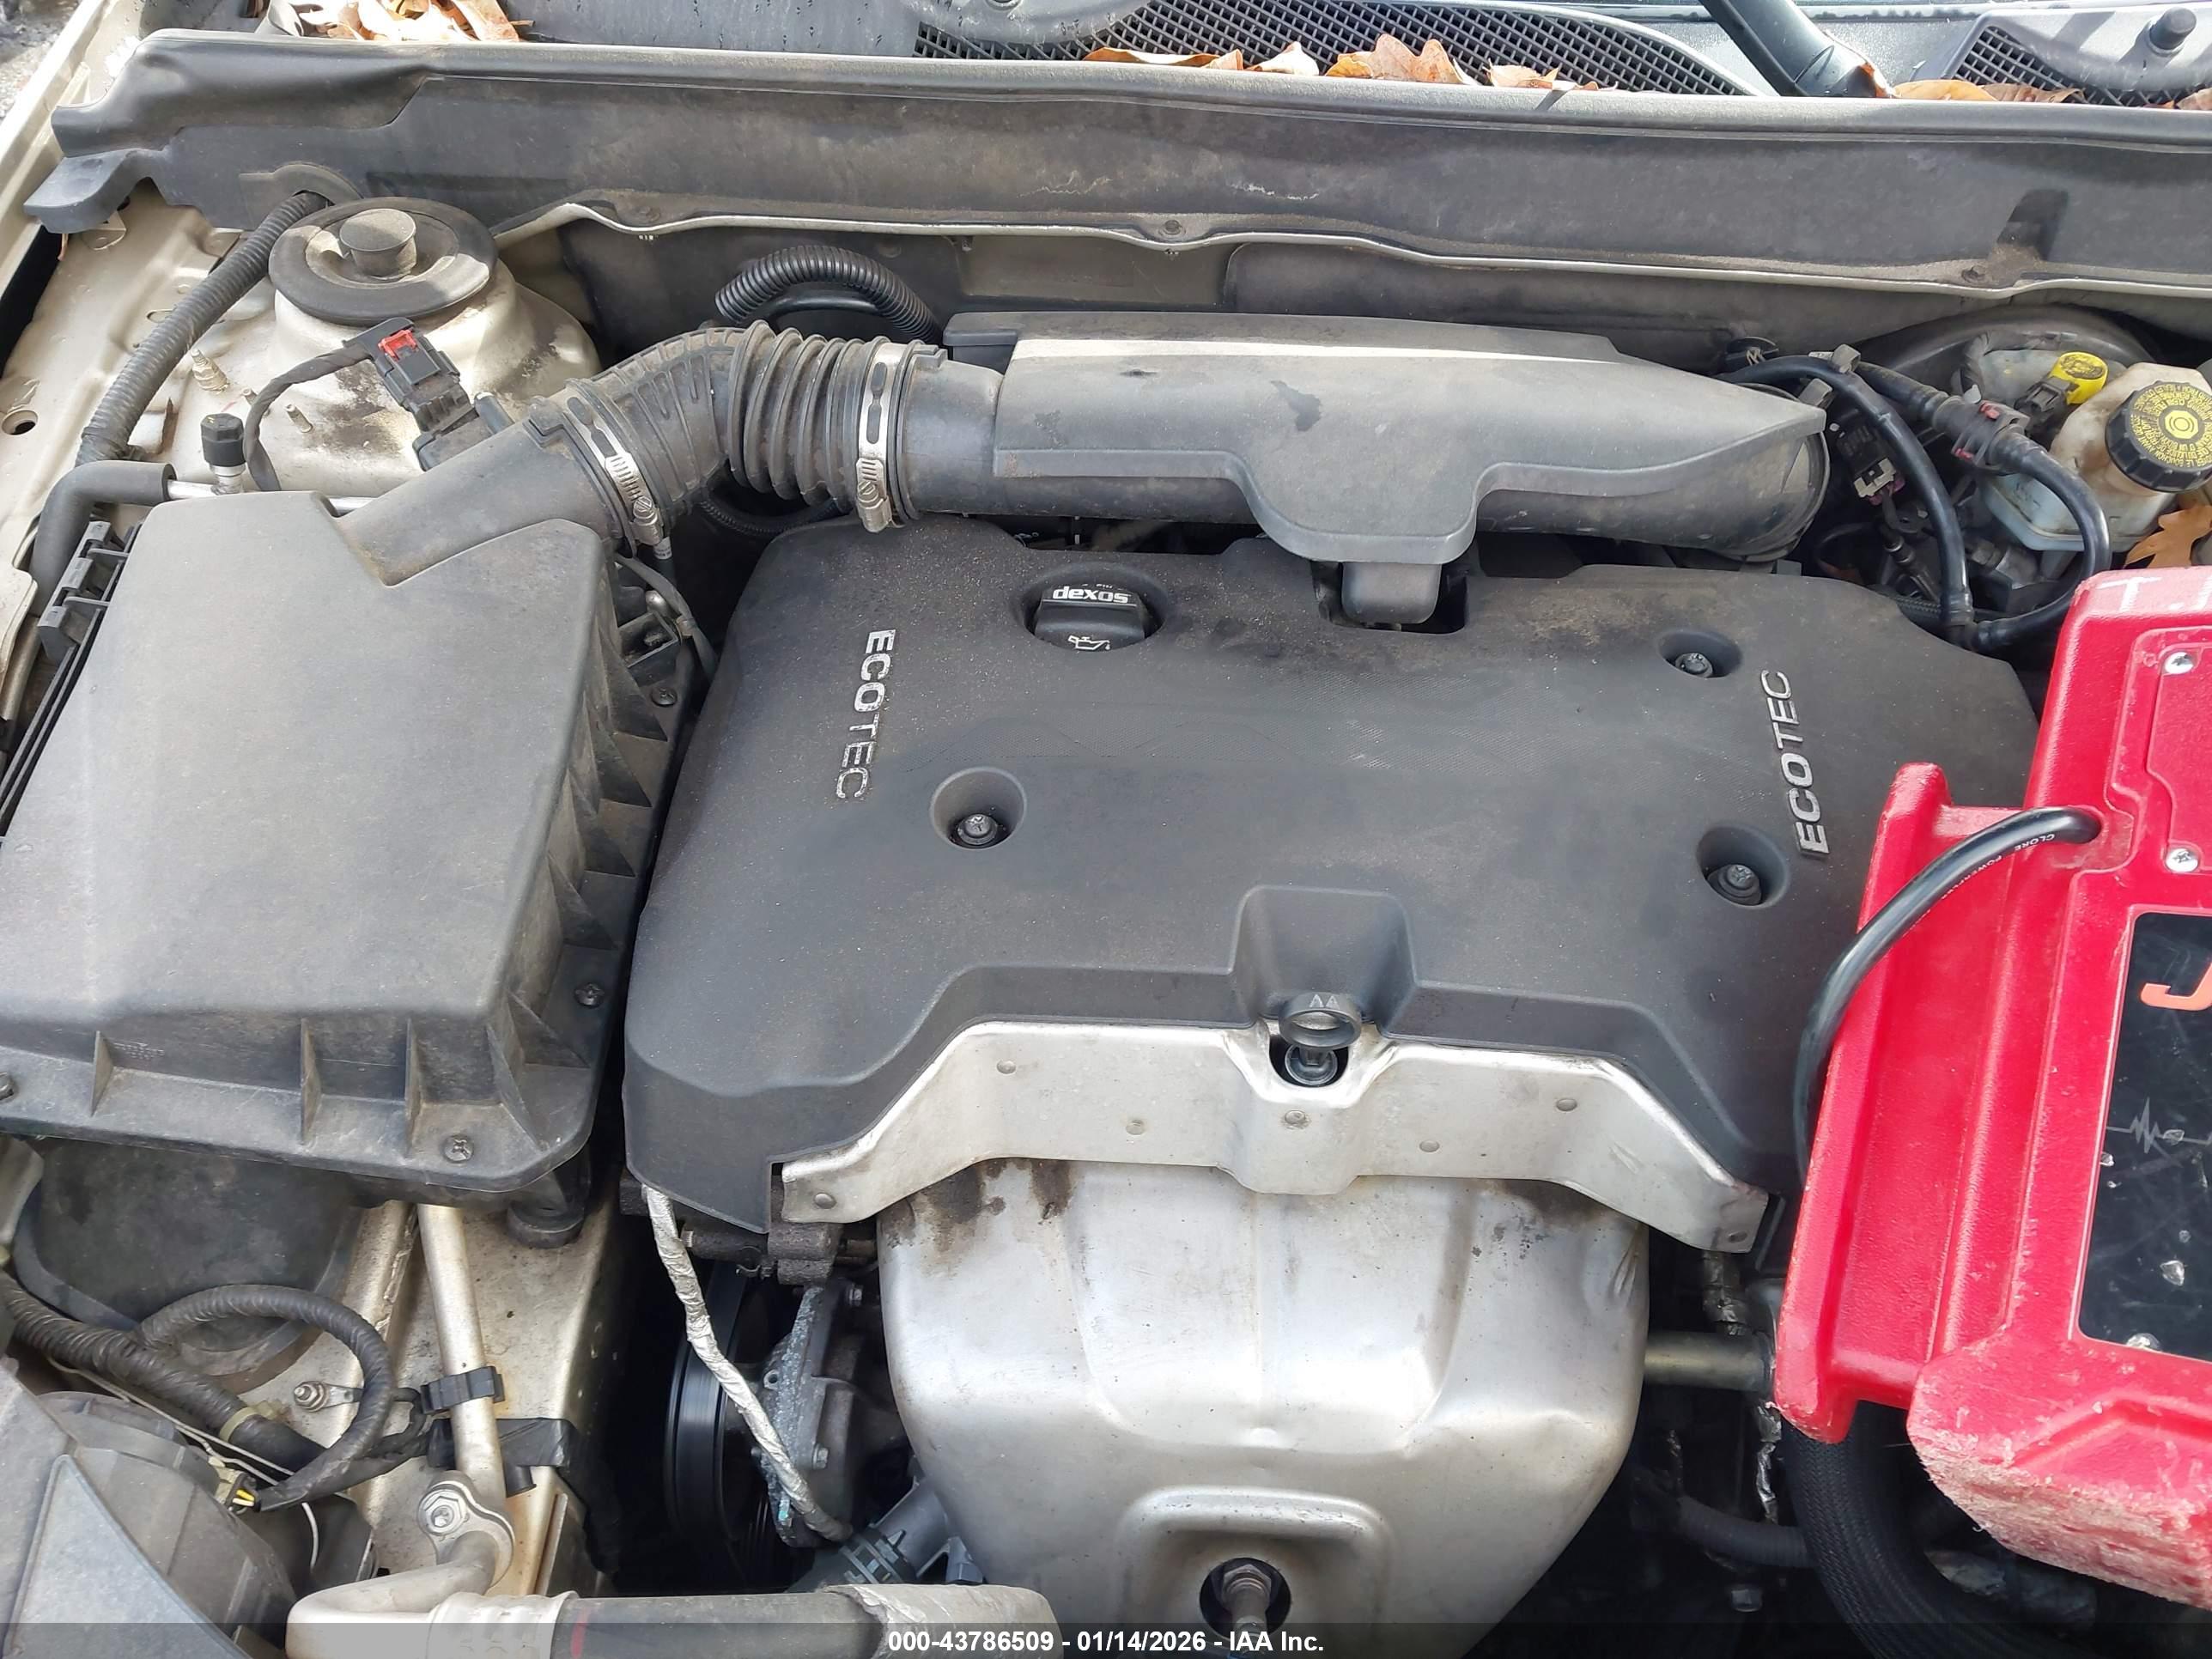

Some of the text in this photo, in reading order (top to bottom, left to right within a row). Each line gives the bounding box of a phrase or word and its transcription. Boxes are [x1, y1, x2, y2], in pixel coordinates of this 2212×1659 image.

[1052, 586, 1132, 604] dexos
[836, 629, 896, 798] ECOTEC
[1760, 669, 1830, 854] ECOTEC
[2014, 833, 2055, 851] CLORE
